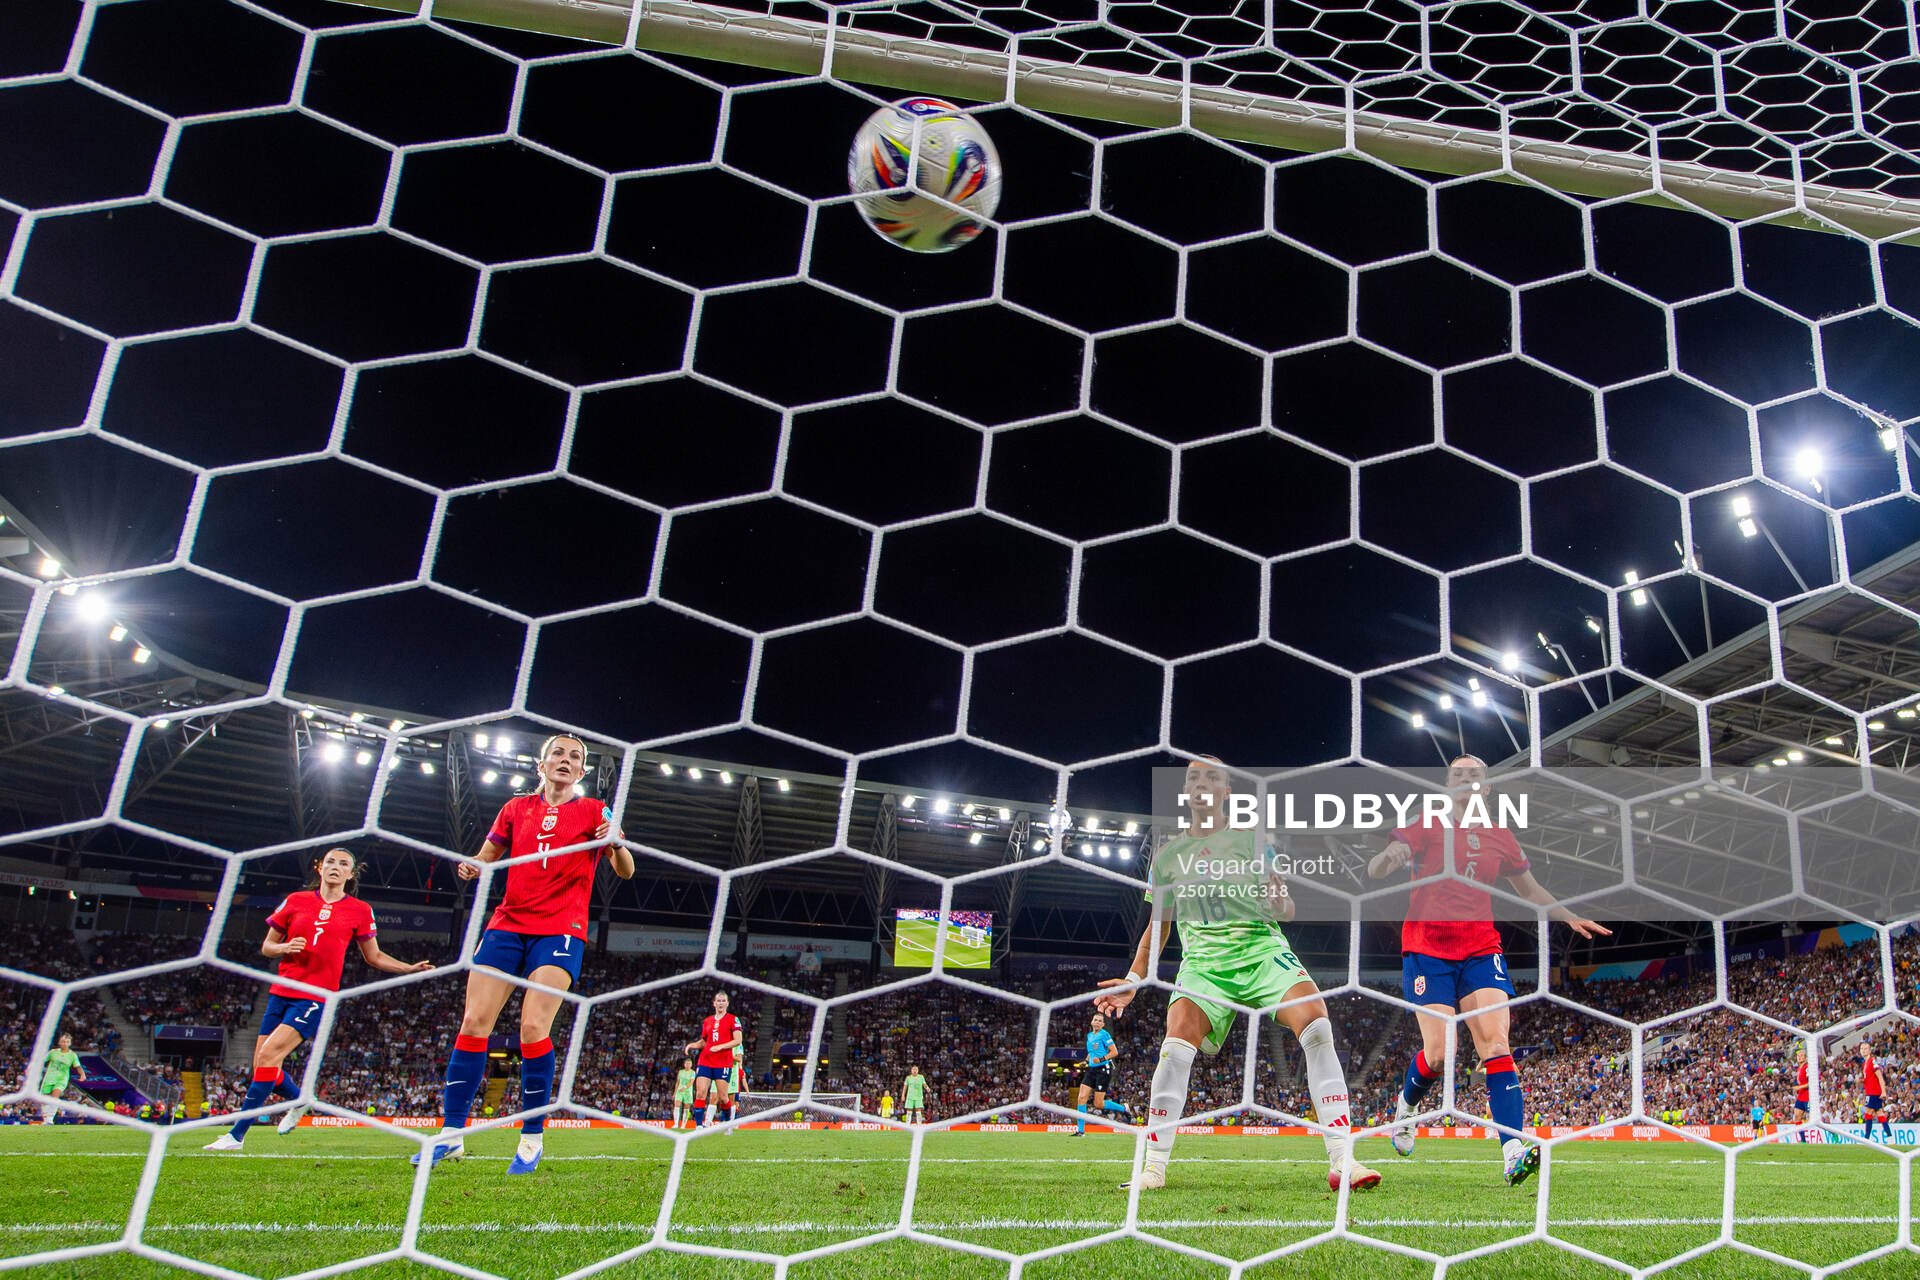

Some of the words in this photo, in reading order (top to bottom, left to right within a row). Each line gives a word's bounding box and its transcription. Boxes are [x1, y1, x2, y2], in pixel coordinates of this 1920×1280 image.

[537, 842, 550, 869] 4
[1197, 893, 1227, 925] 18
[378, 915, 402, 924] NEVA
[313, 927, 325, 946] 7
[304, 1001, 319, 1018] 7
[185, 1029, 194, 1037] H
[1071, 1050, 1078, 1058] K
[311, 1116, 357, 1127] amazon
[391, 1117, 437, 1128] amazon
[547, 1118, 591, 1128] amazon
[770, 1121, 811, 1130] amazon
[841, 1121, 881, 1131] amazon
[980, 1124, 1018, 1132] amazon
[1047, 1124, 1079, 1133] amazo
[1178, 1125, 1214, 1134] amazon
[1242, 1126, 1279, 1135] amazon
[1632, 1126, 1660, 1138] amazon
